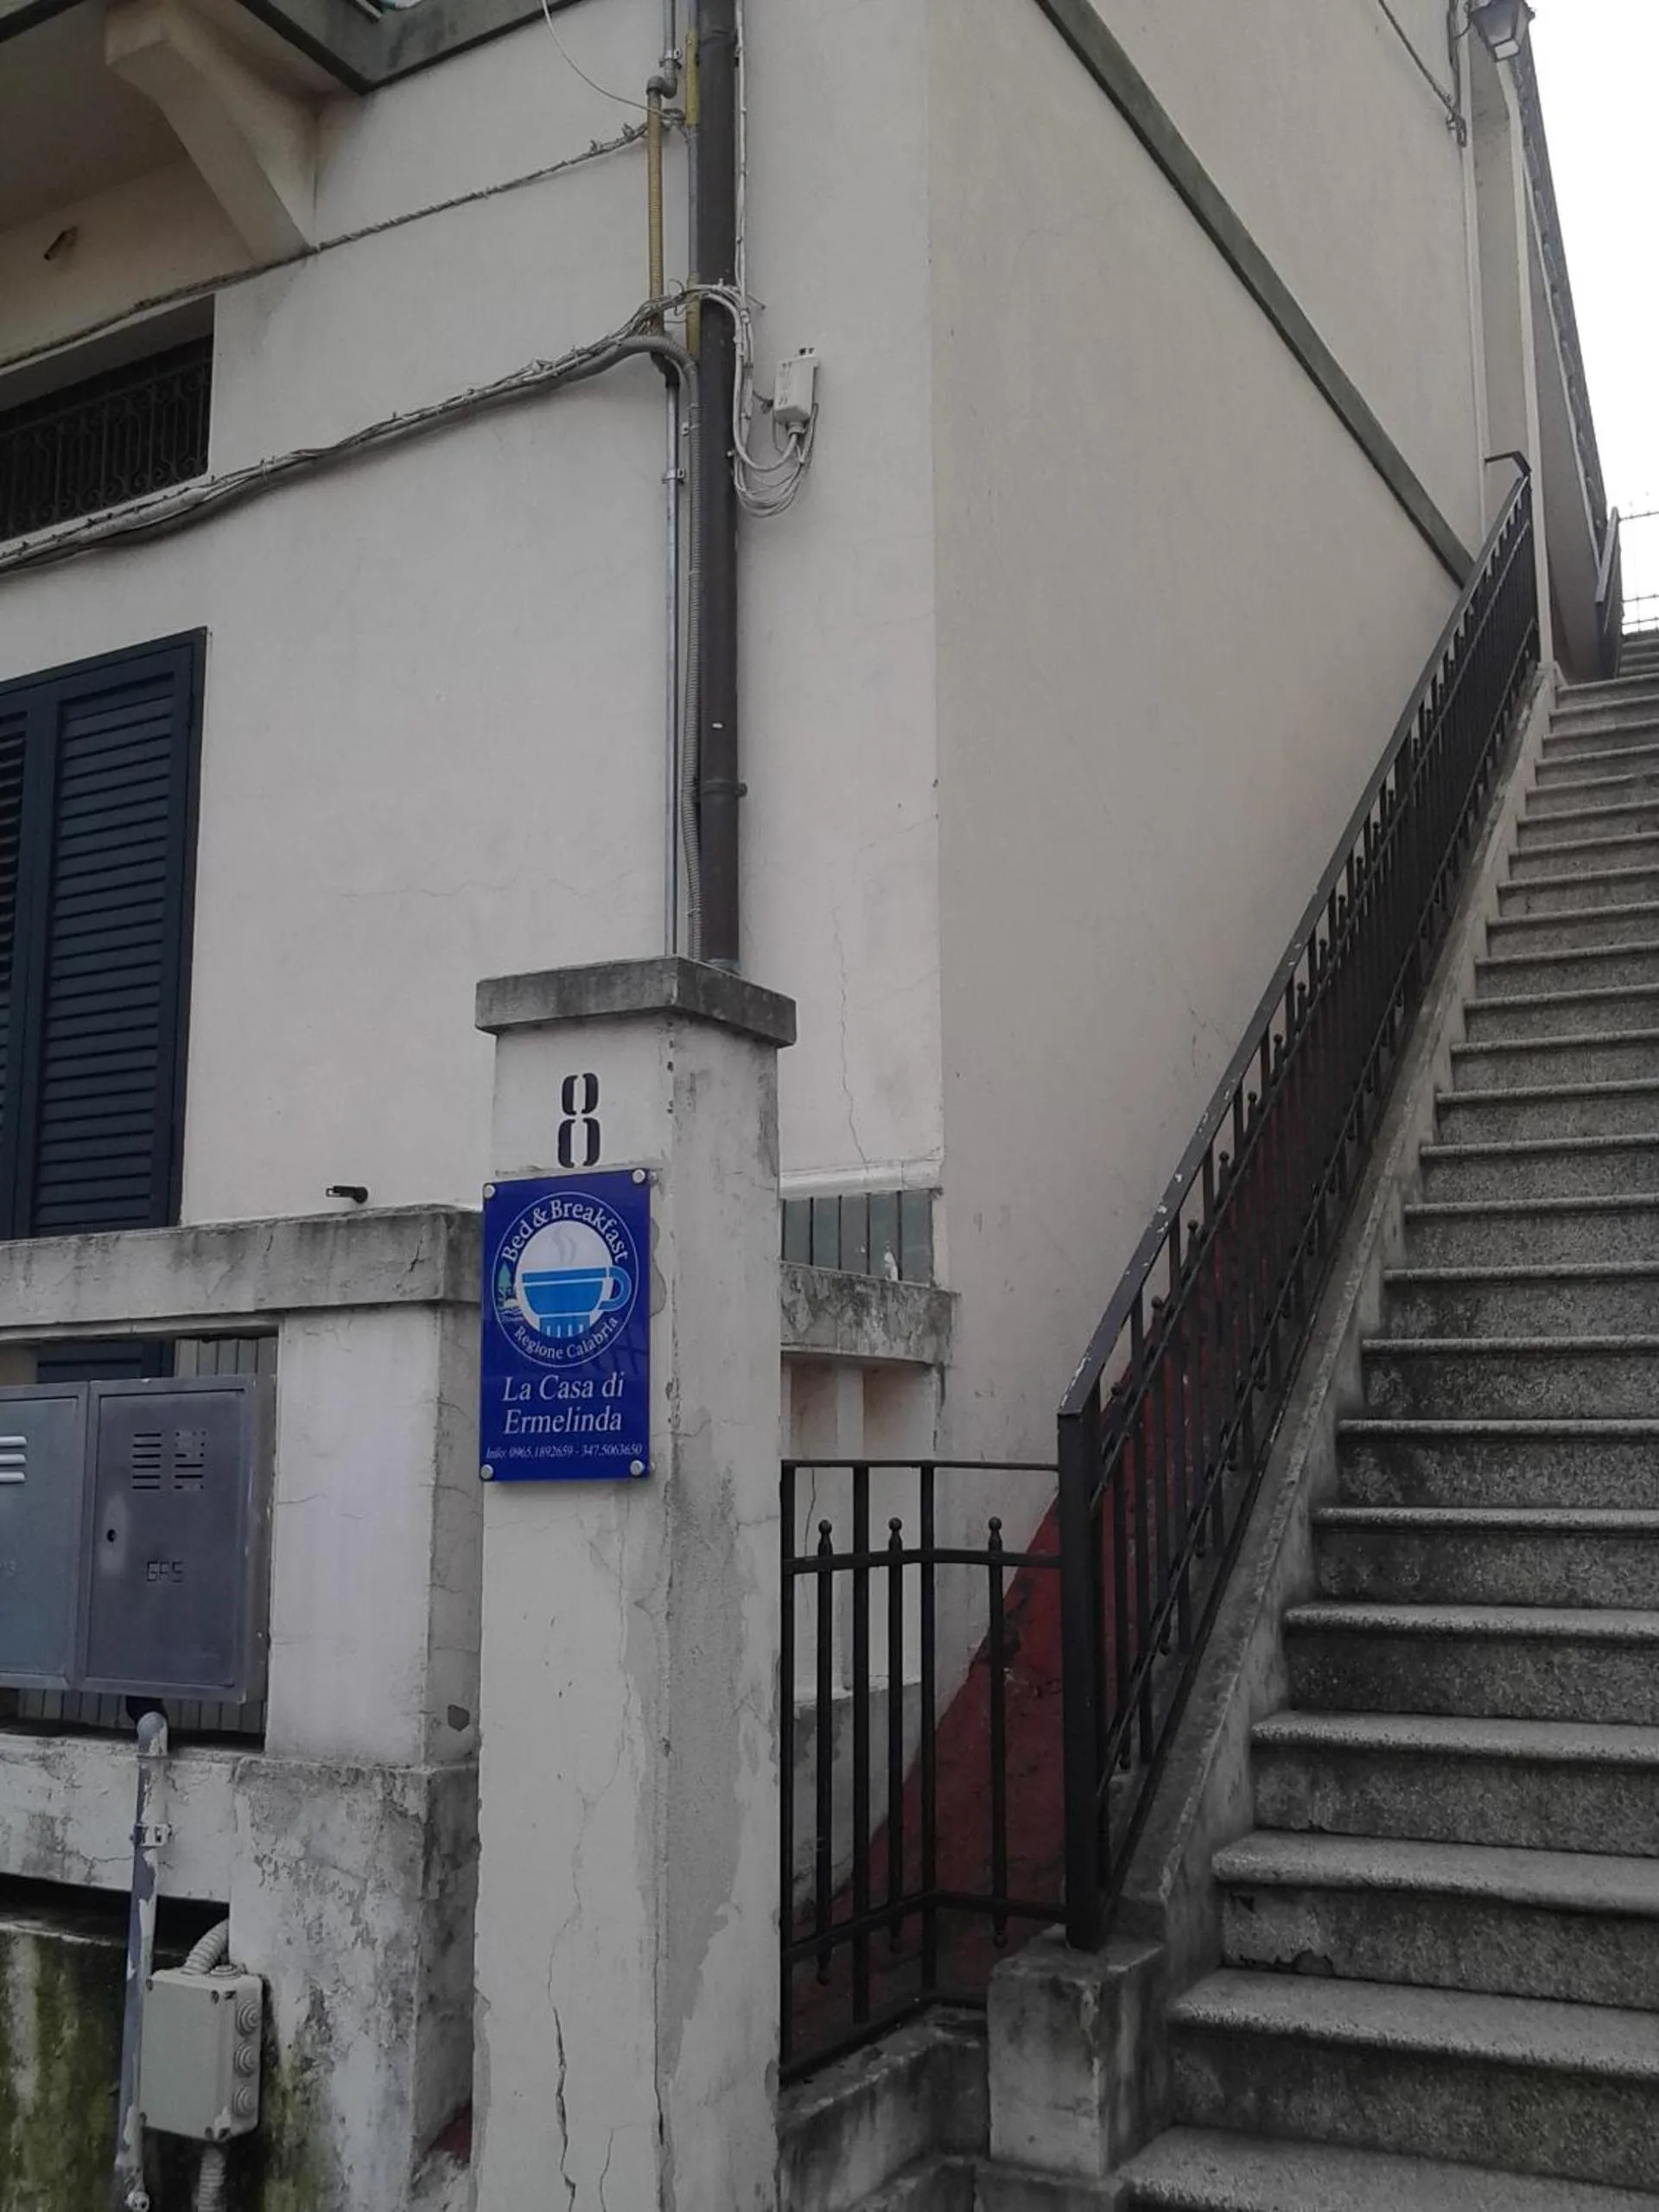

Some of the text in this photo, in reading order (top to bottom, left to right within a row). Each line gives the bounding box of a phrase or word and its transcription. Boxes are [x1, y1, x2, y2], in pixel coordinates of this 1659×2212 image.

[557, 1072, 601, 1168] 8
[501, 1199, 629, 1263] Bed & Breakfast
[514, 1317, 619, 1359] Regione Calabria
[502, 1371, 625, 1402] La Casa di
[504, 1405, 622, 1434] Ermelinda
